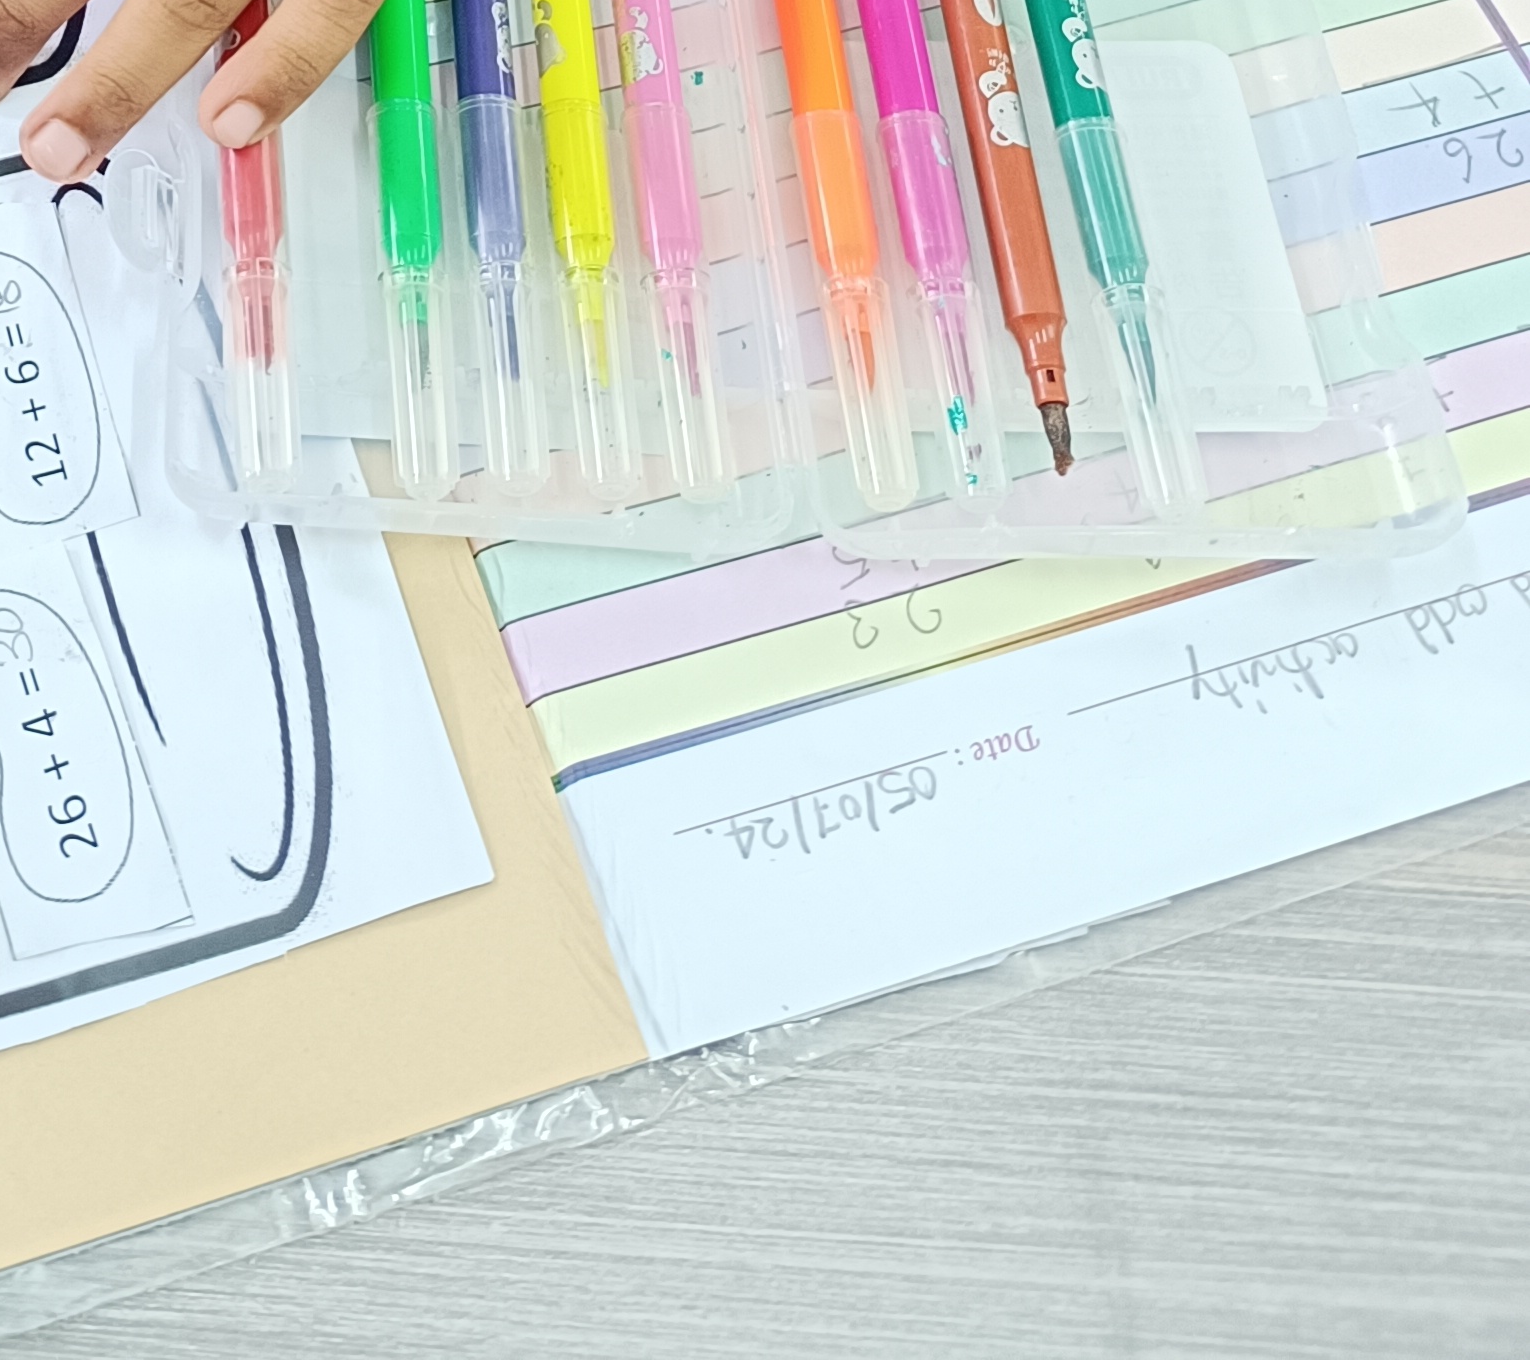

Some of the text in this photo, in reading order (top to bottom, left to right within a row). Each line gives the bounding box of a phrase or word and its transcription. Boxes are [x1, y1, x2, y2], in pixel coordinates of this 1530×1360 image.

[1443, 128, 1524, 184] 26
[4, 360, 40, 384] 6
[24, 433, 68, 487] 12
[843, 582, 943, 650] 23
[1403, 583, 1488, 655] odd
[1184, 631, 1359, 715] activity
[21, 708, 57, 737] 4
[48, 794, 99, 859] 26
